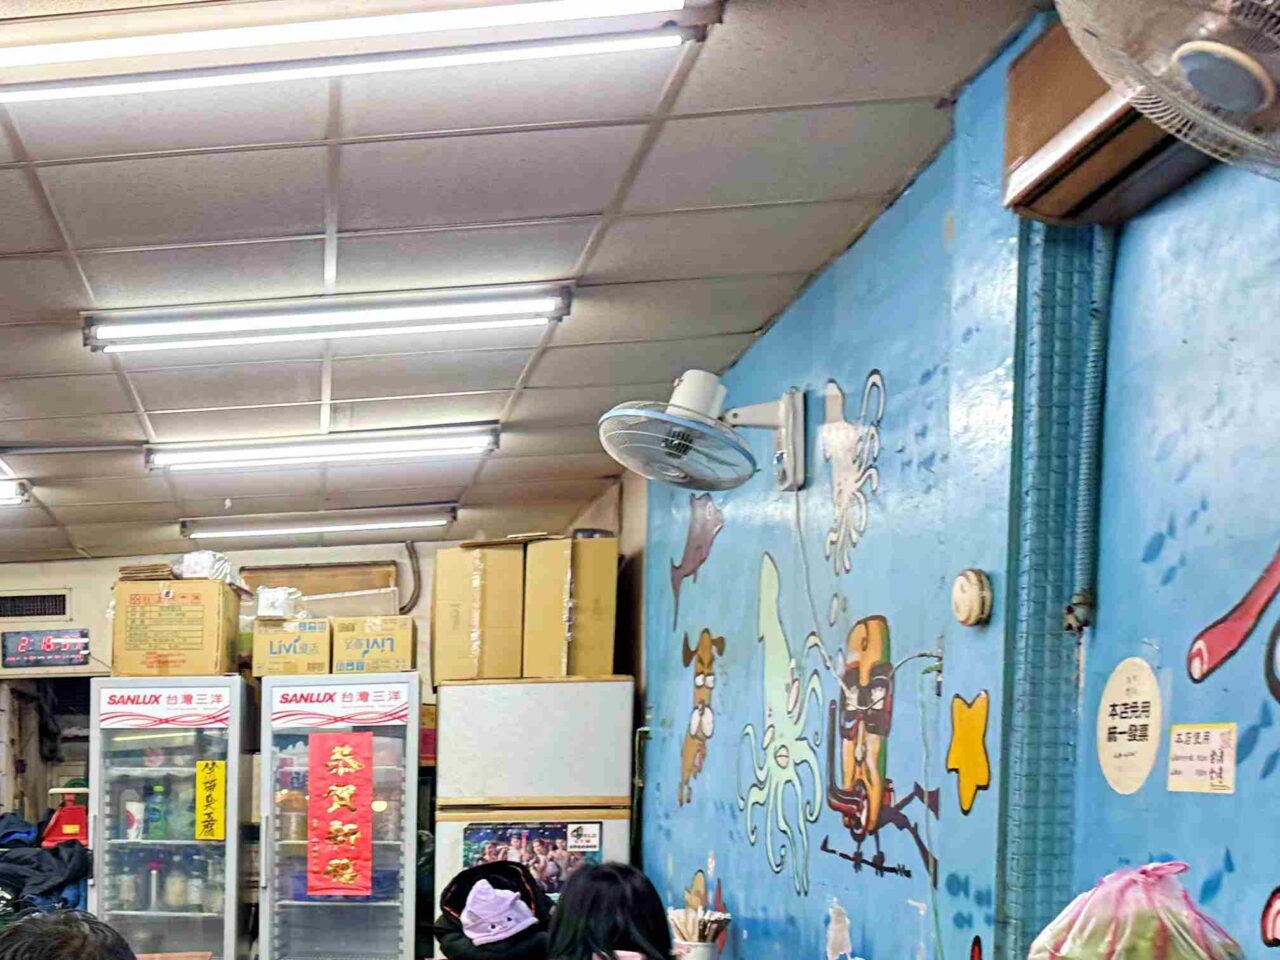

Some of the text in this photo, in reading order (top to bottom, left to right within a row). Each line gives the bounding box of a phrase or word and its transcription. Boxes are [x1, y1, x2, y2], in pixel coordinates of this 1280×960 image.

[107, 693, 223, 705] SANLUX 台灣三洋
[280, 690, 401, 704] SANLUX 台灣三洋
